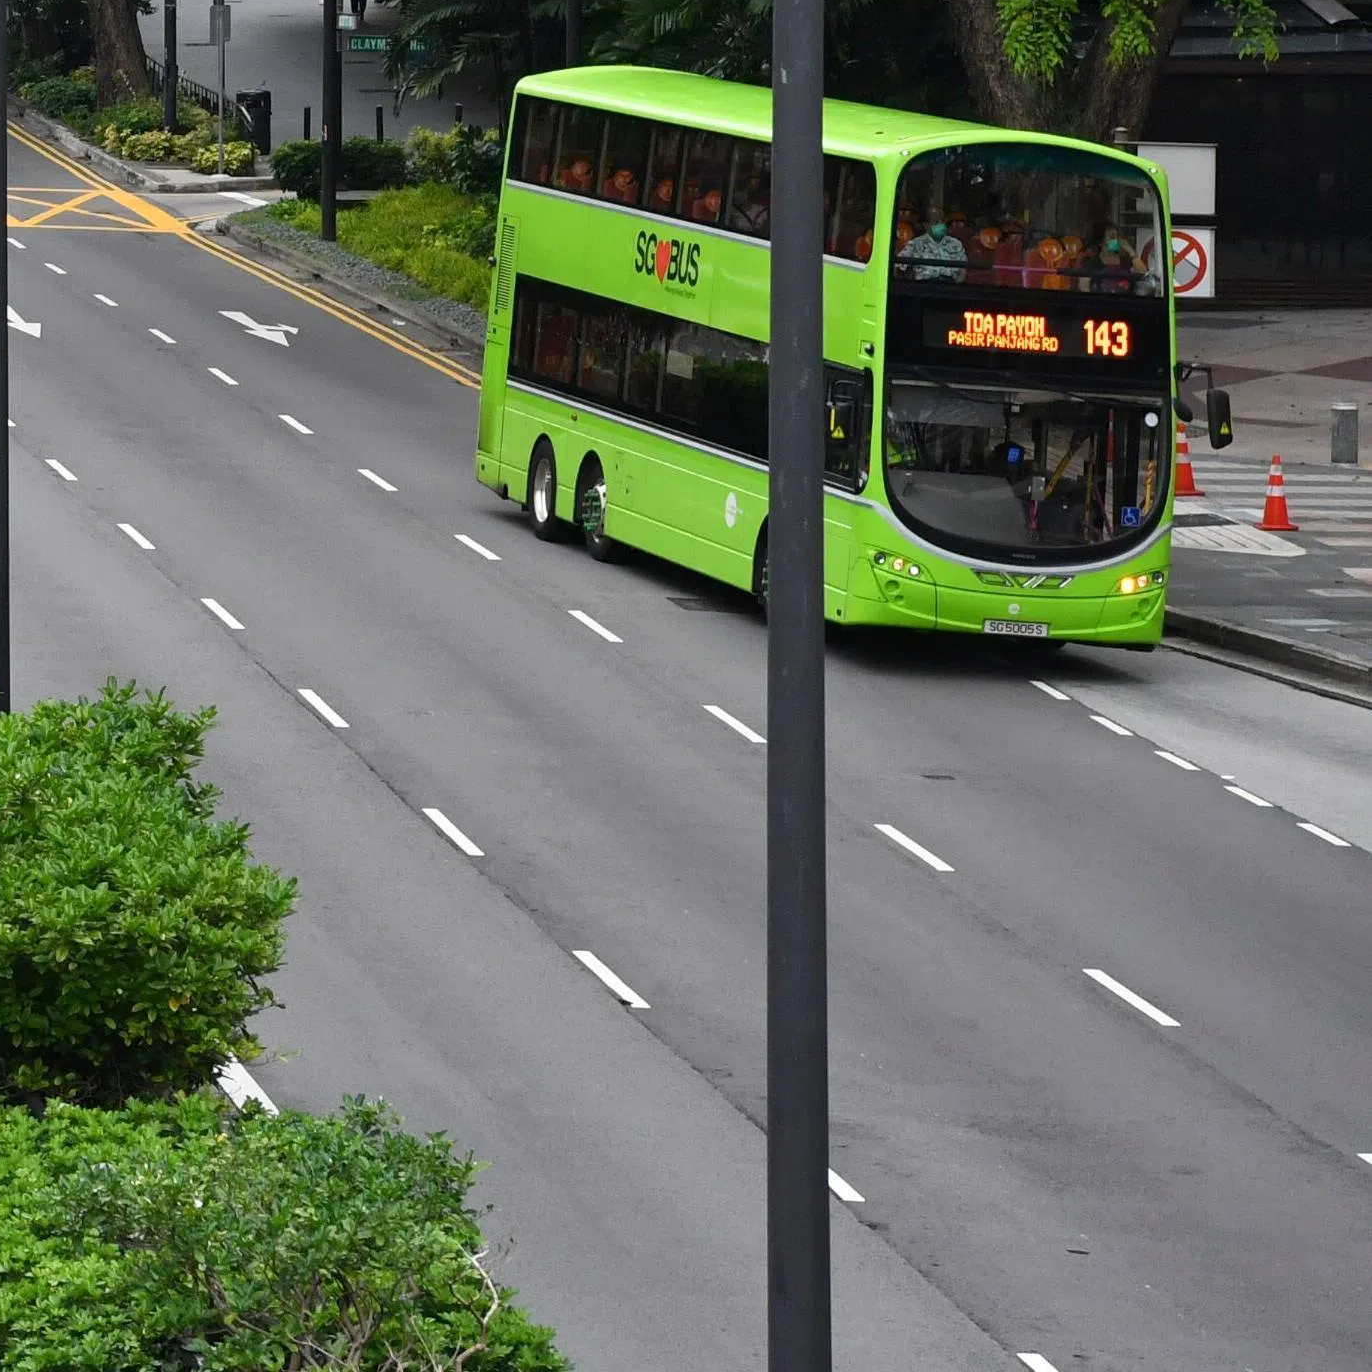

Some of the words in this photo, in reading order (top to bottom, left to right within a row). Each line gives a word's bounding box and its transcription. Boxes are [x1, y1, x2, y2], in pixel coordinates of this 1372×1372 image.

[948, 330, 985, 347] PASIR
[986, 333, 1041, 351] PANJANG
[1042, 337, 1059, 353] RD
[963, 311, 994, 334] TOA
[996, 314, 1045, 337] PAYOH
[1083, 319, 1130, 357] 143
